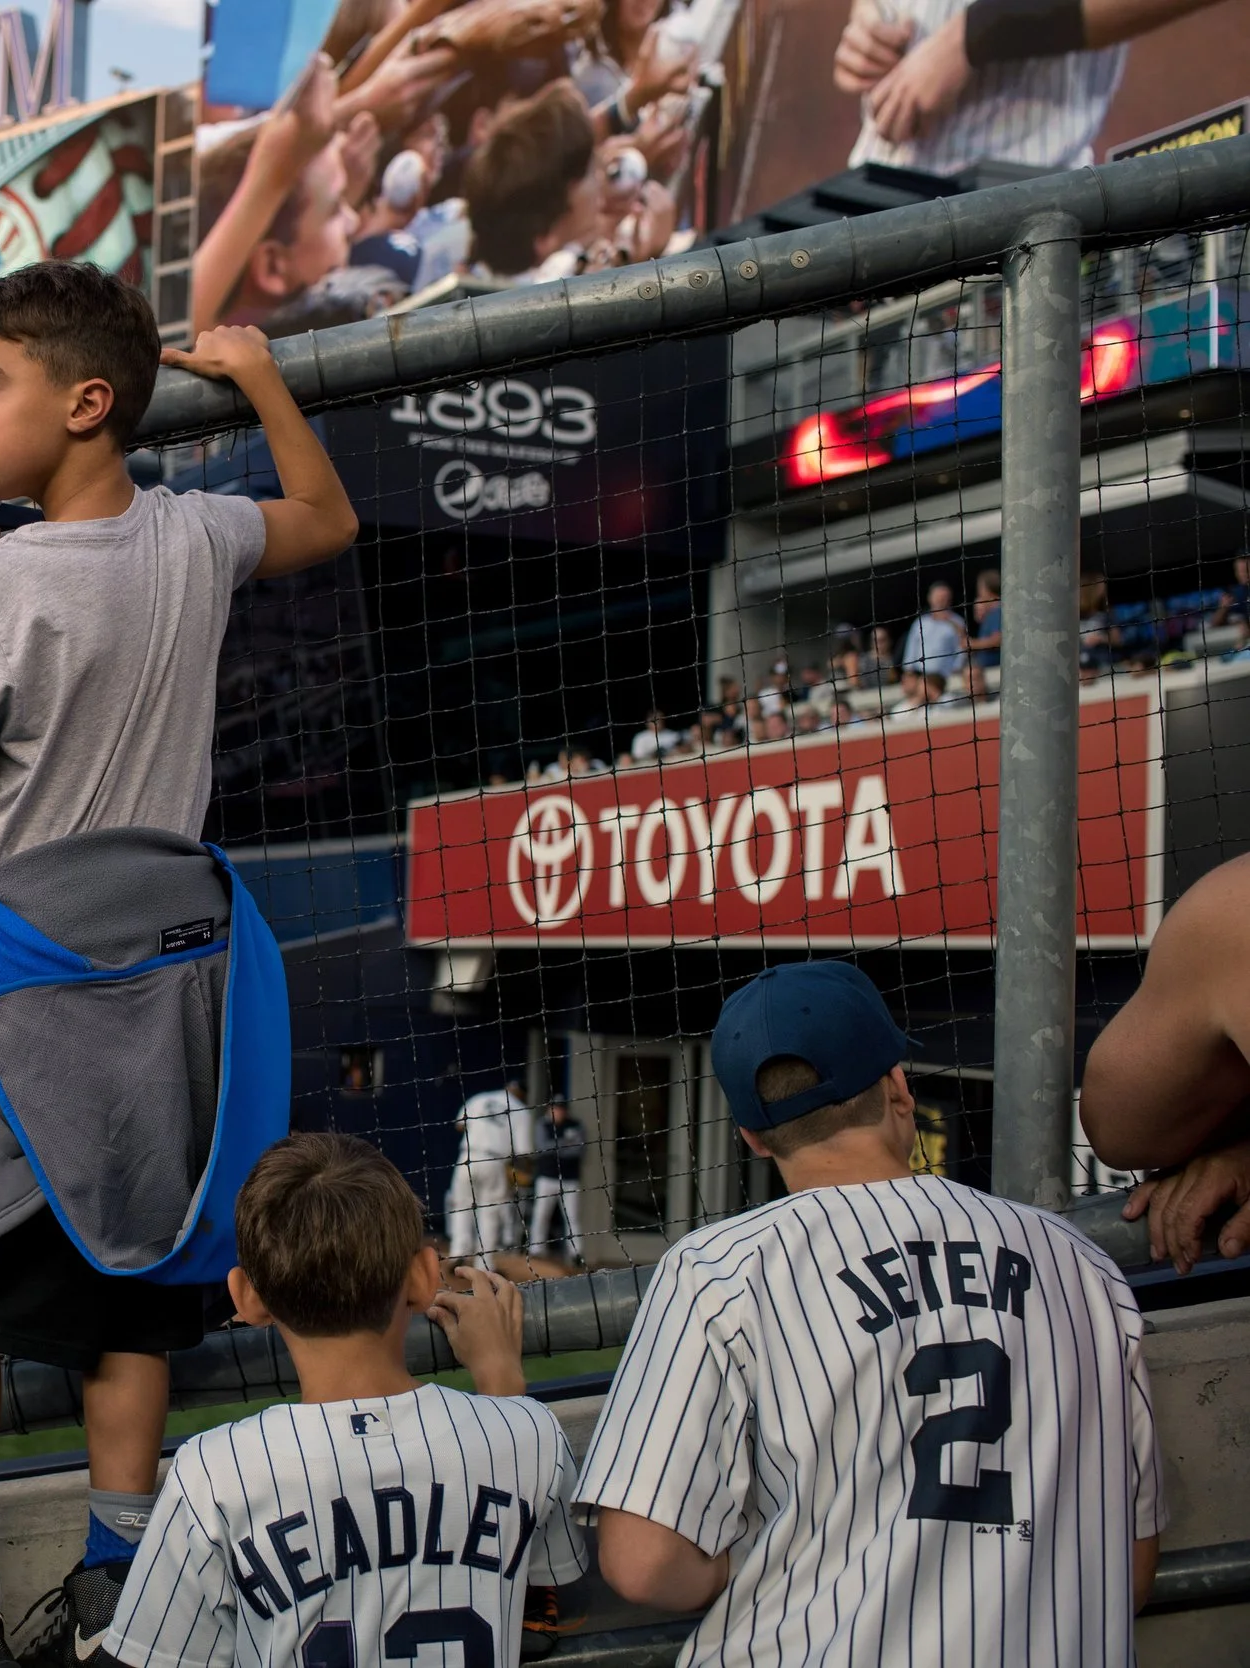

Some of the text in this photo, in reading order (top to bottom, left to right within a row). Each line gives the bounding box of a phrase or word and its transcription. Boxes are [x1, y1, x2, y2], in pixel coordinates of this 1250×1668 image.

[600, 775, 906, 908] TOYOTA
[836, 1240, 1032, 1335] JETER
[903, 1337, 1015, 1525] 2
[232, 1482, 537, 1620] HEADLEY
